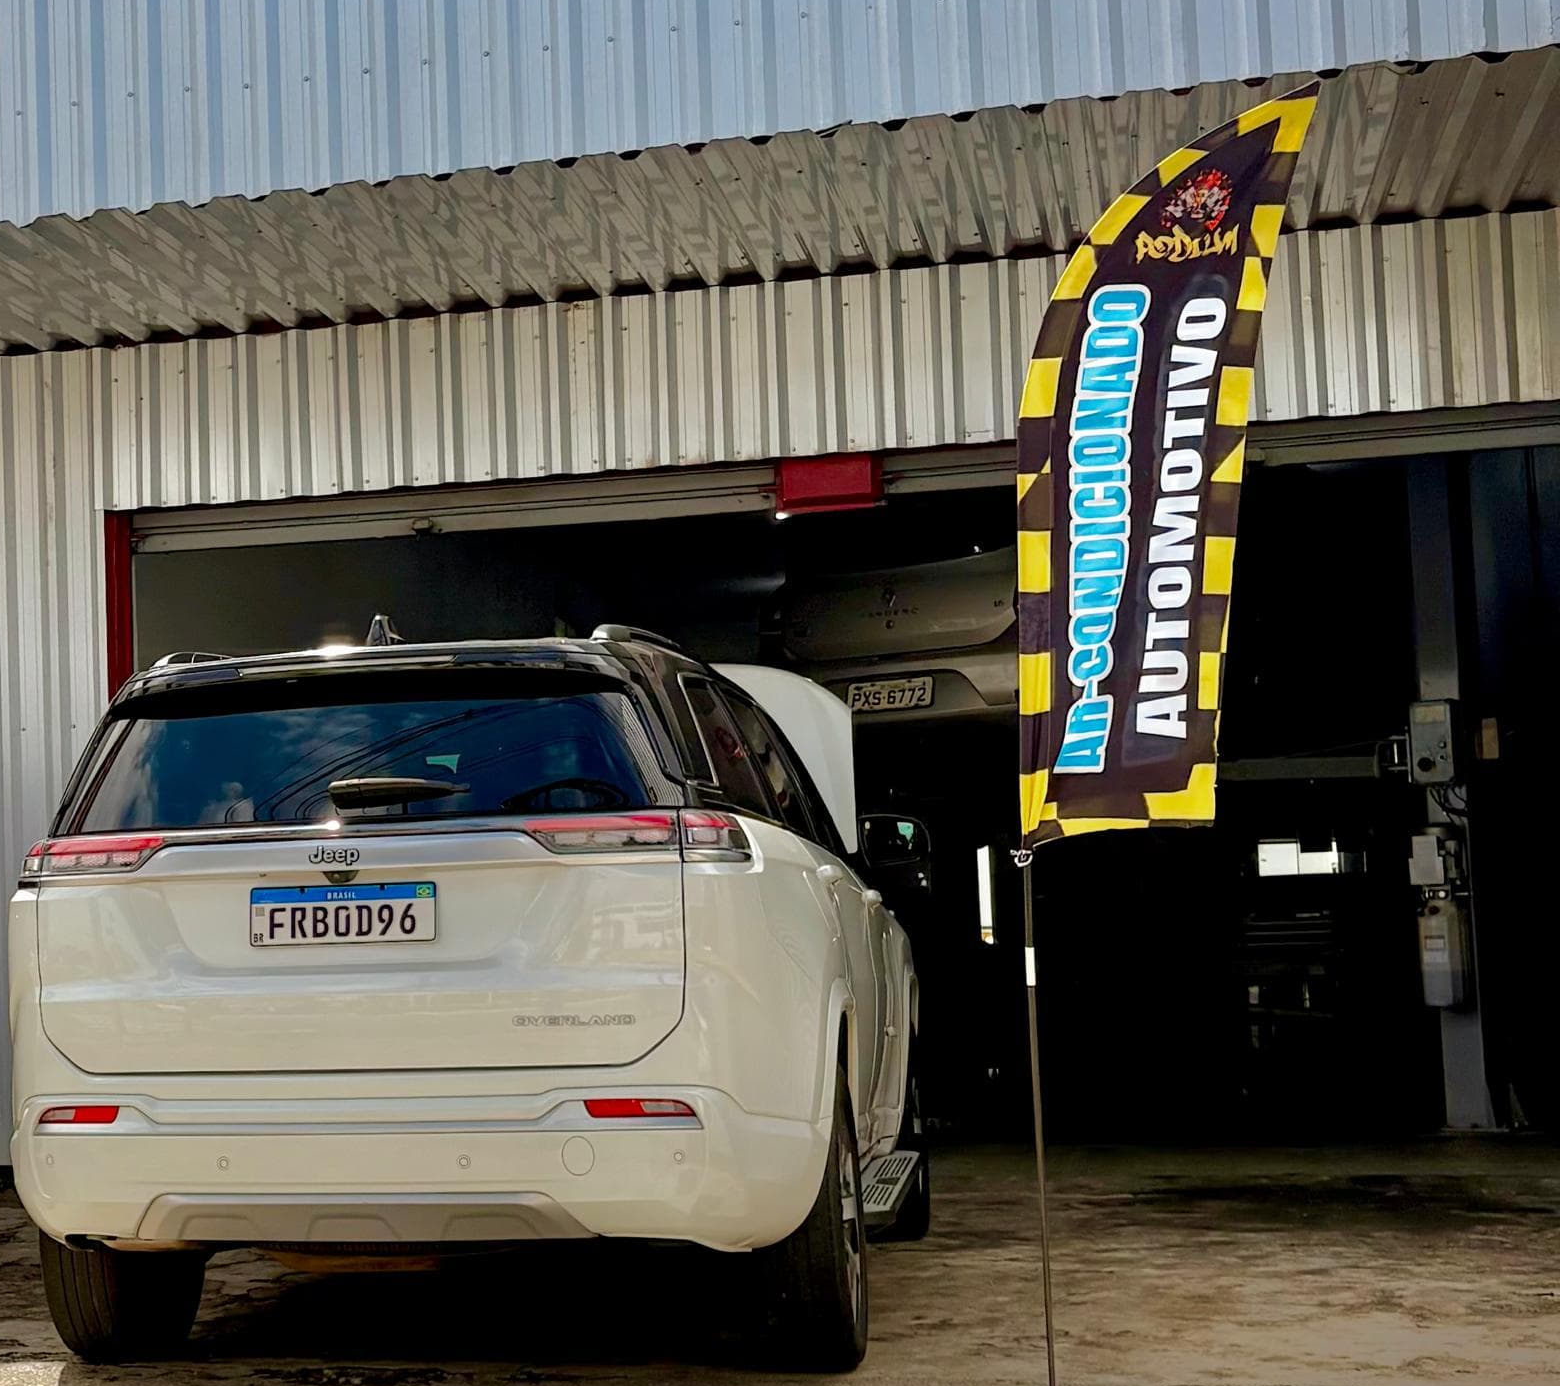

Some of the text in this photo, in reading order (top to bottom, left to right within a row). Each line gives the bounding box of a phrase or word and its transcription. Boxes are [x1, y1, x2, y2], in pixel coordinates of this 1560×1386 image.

[1135, 224, 1240, 264] PODIUM
[1053, 284, 1151, 774] AR-CONDICIONADO
[1135, 297, 1227, 739] AUTOMOTIVO
[309, 846, 360, 865] Jeep
[327, 892, 356, 900] BRASIL
[512, 1014, 636, 1027] OVERLAND
